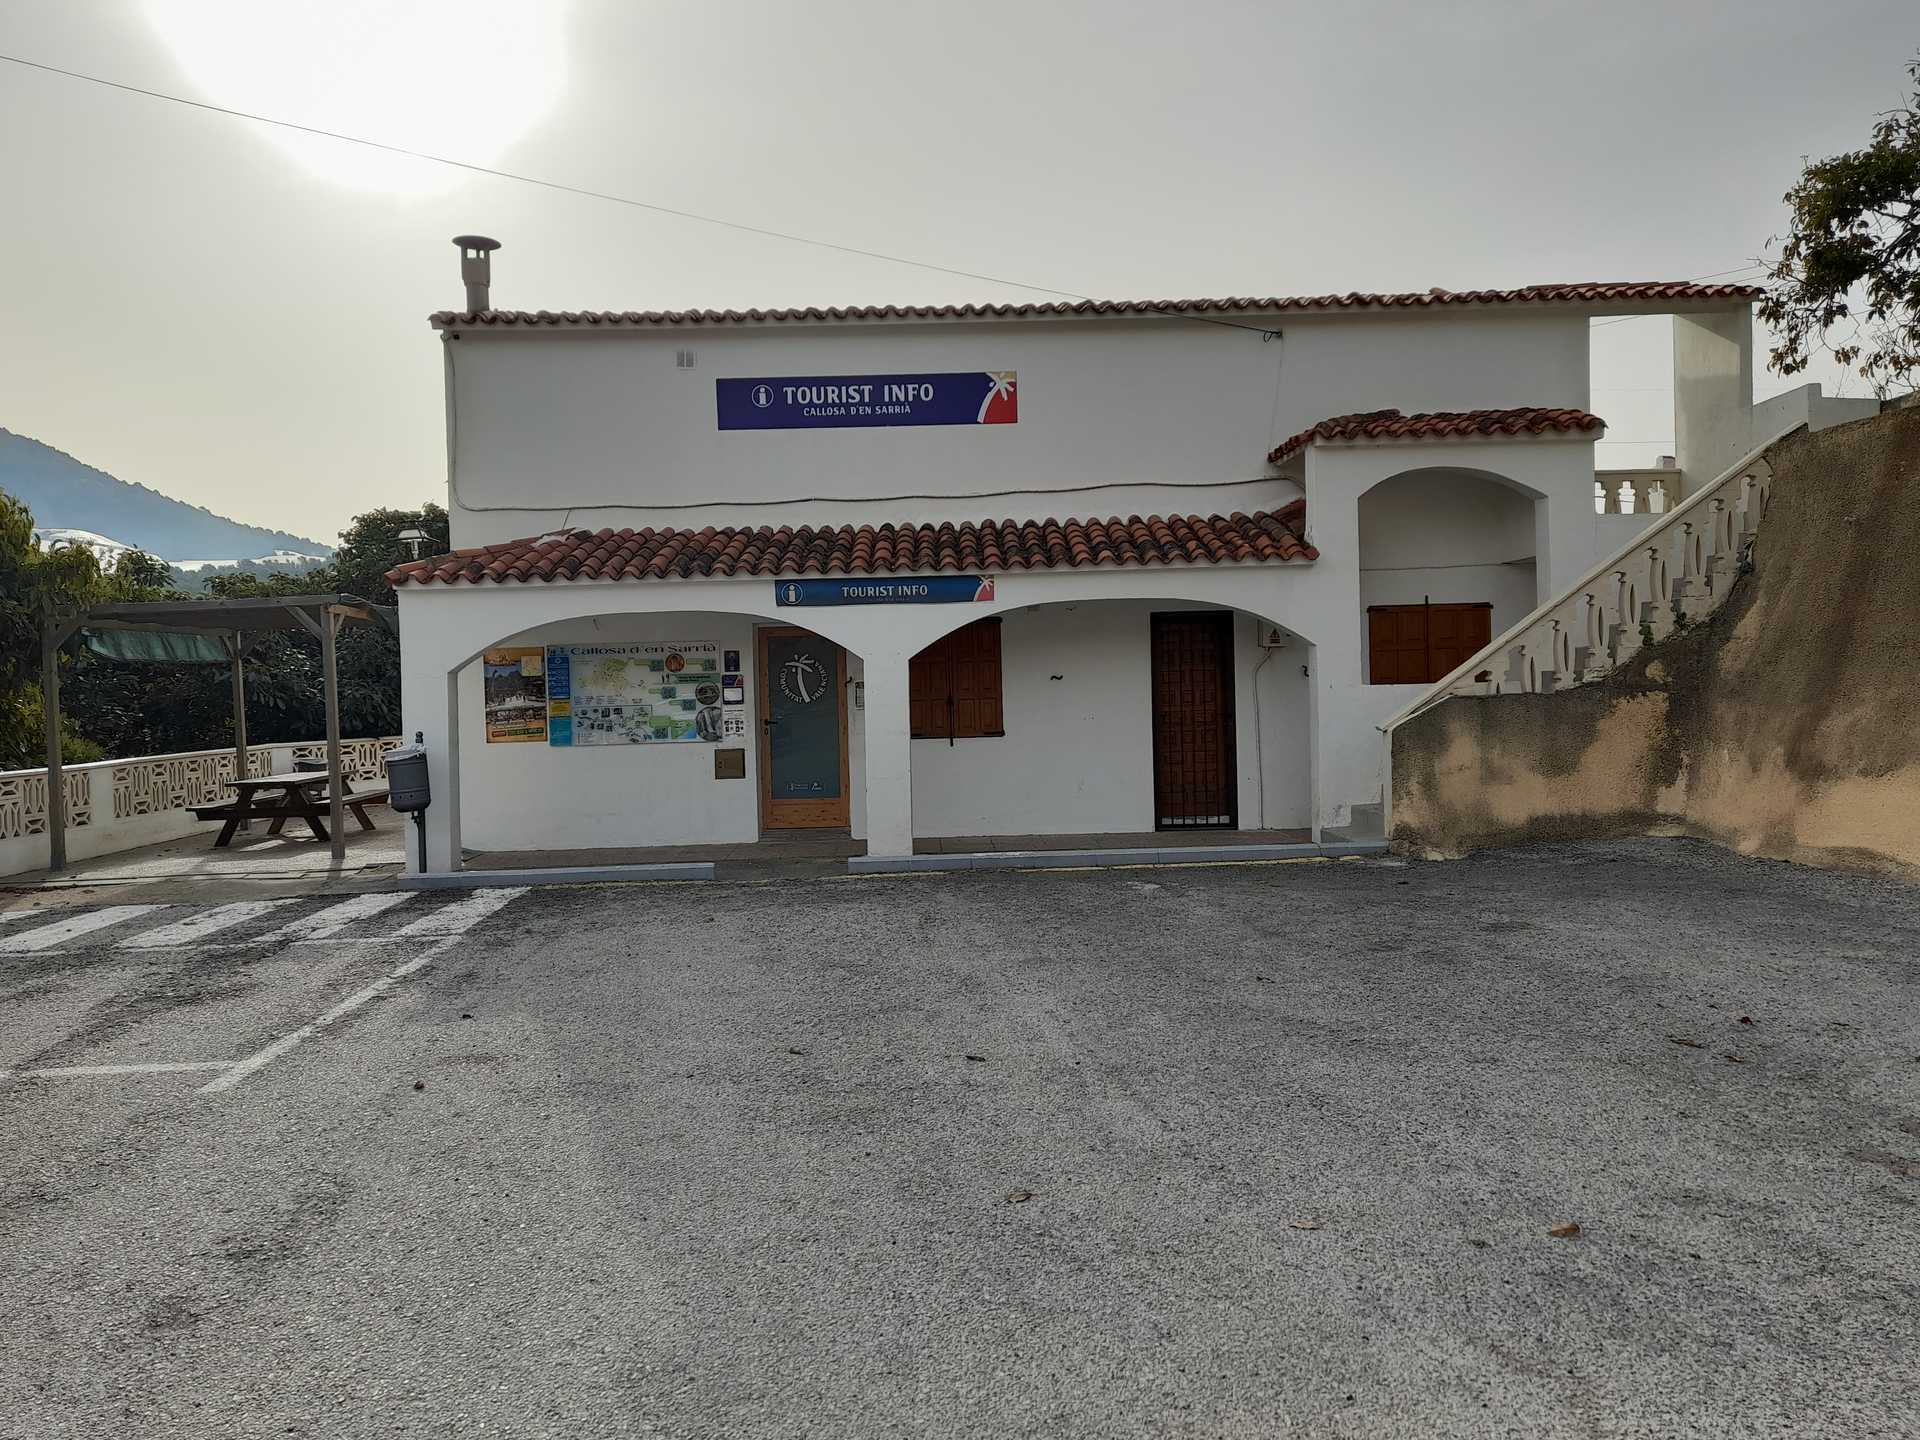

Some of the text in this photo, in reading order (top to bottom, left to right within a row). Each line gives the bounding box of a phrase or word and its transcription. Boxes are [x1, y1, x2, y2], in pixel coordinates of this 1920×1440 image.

[783, 385, 873, 405] TOURIST
[884, 383, 934, 402] INFO
[803, 402, 911, 416] CALLOSA D'EN SARRIÀ
[842, 586, 895, 598] TOURIST
[898, 585, 928, 596] INFO
[570, 647, 626, 655] Callosa
[780, 668, 803, 703] COMUNITAT
